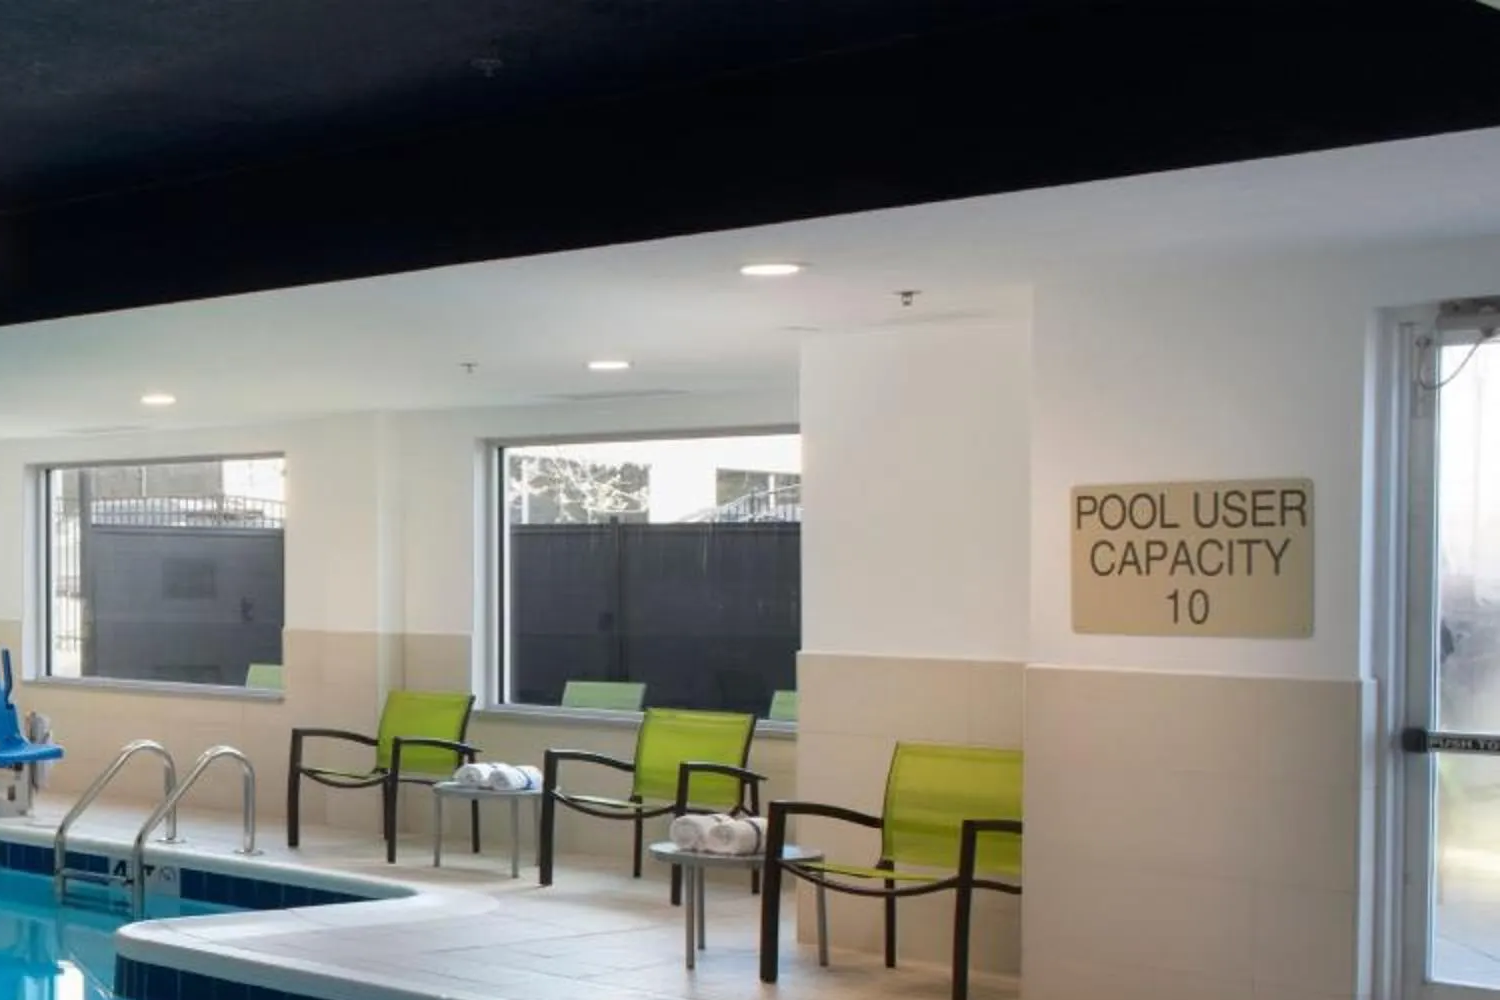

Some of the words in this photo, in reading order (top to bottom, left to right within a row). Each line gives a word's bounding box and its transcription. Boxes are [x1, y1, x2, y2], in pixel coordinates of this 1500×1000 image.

[1076, 493, 1181, 530] POOL
[1193, 489, 1307, 528] USER
[1090, 538, 1291, 576] CAPACITY
[1166, 588, 1210, 624] 10
